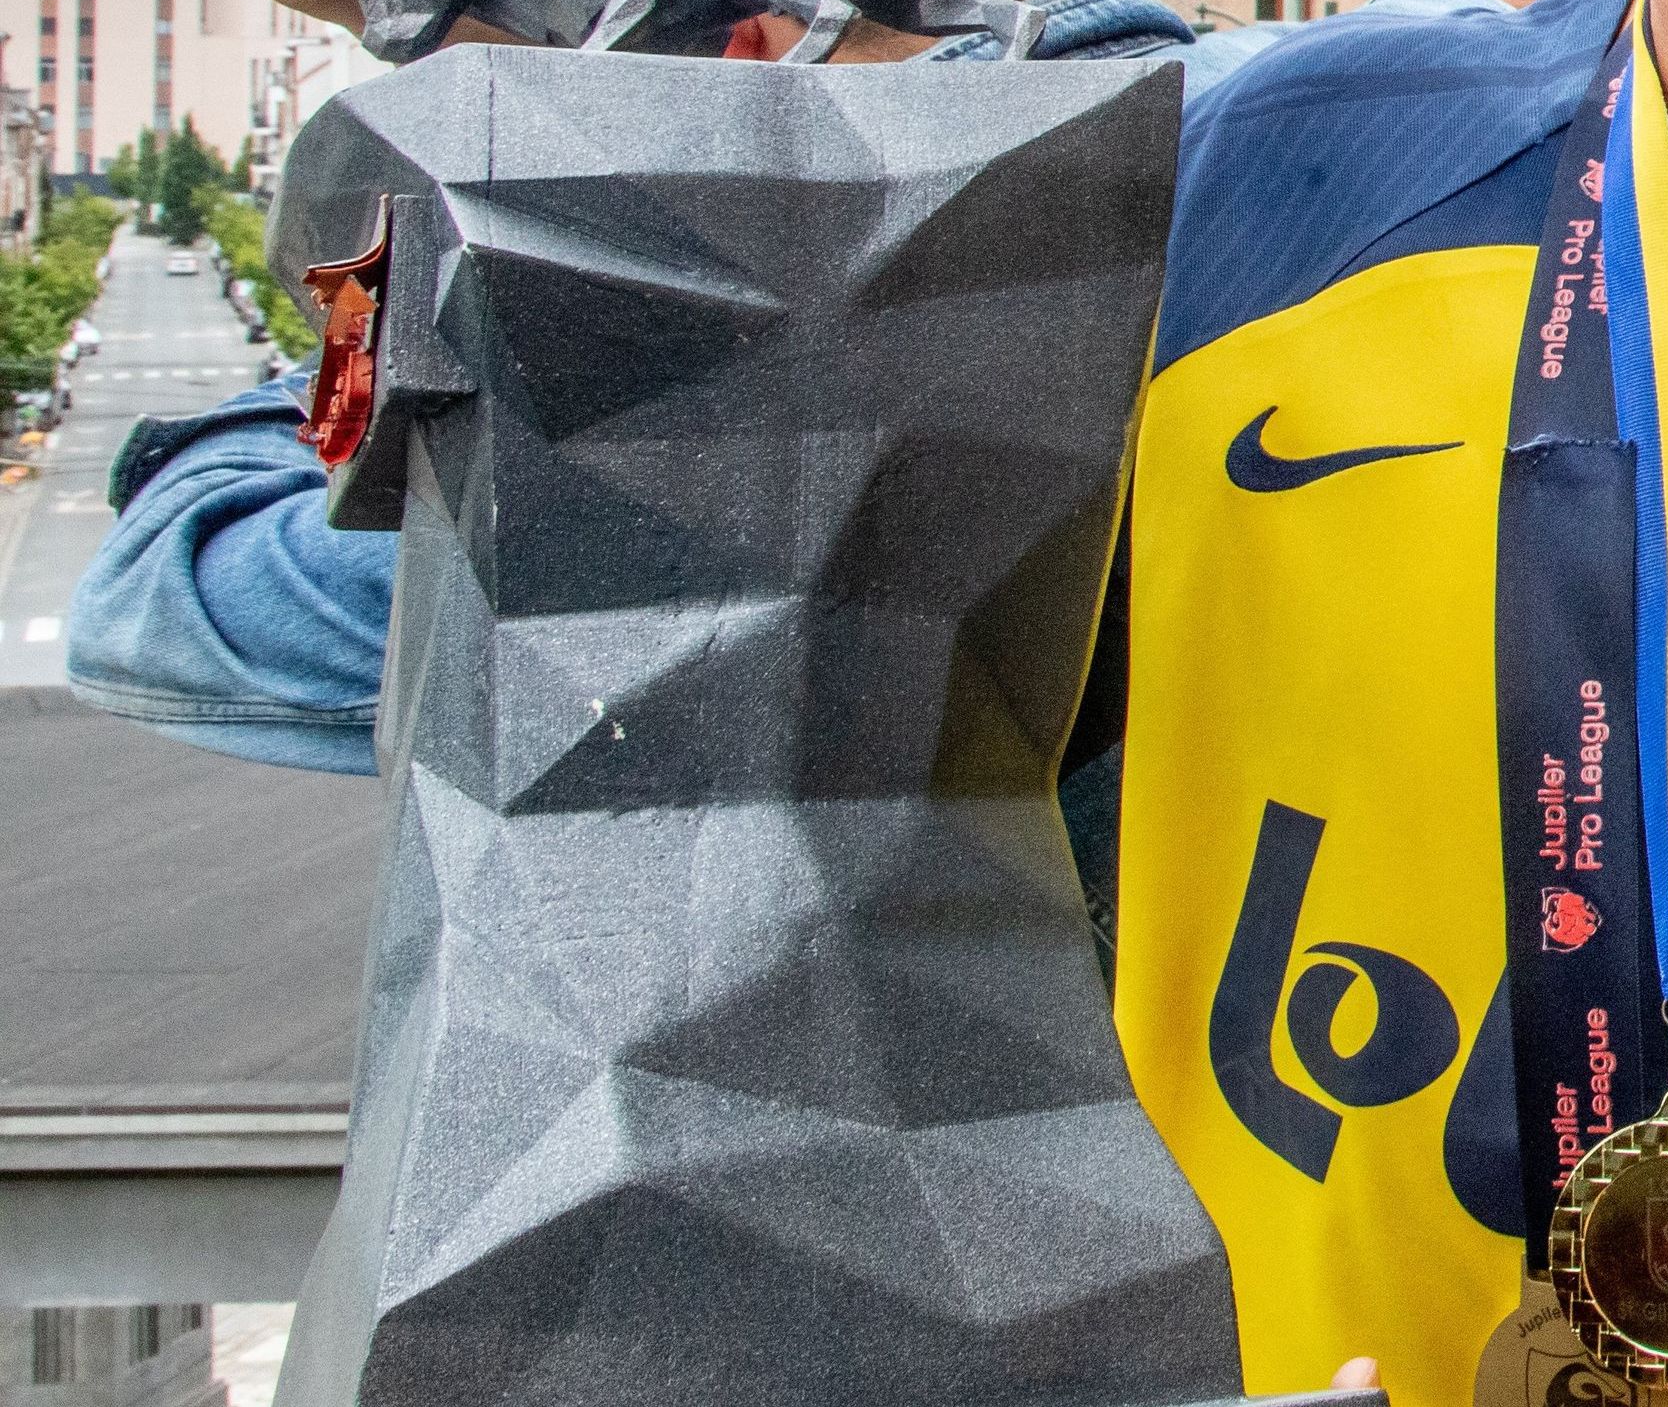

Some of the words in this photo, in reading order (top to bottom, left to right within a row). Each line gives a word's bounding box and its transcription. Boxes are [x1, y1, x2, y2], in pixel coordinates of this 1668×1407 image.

[1561, 219, 1595, 265] Pro
[1539, 273, 1585, 380] League
[1573, 679, 1610, 804] League
[1537, 753, 1567, 872] Jupiler
[1574, 813, 1604, 871] Pro
[1586, 1007, 1618, 1135] League
[1517, 1306, 1562, 1338] Jupile
